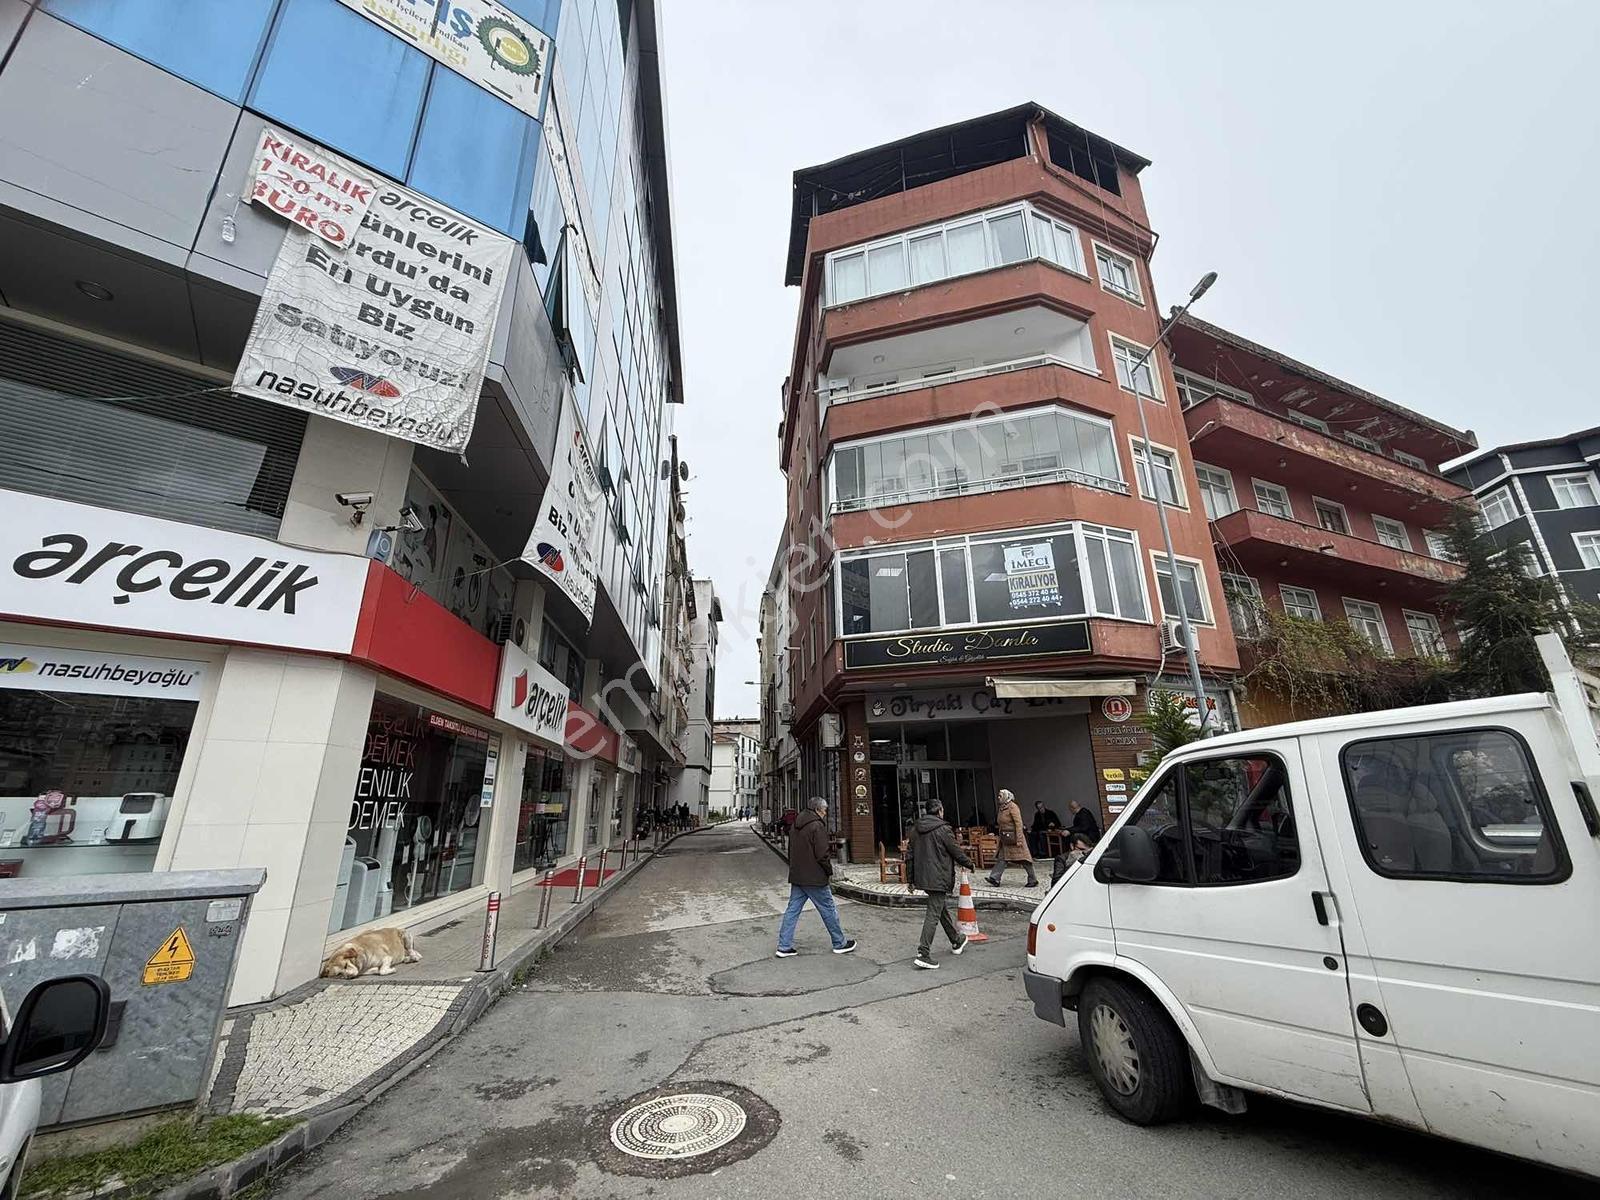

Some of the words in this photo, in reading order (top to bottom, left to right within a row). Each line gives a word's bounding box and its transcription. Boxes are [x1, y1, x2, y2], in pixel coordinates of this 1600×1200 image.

[262, 136, 371, 206] KİRALIK
[379, 192, 479, 246] arçelik
[357, 302, 416, 342] Biz
[365, 273, 475, 335] Uygun
[548, 505, 567, 539] Biz
[12, 533, 319, 615] arçelik
[1011, 555, 1049, 569] İMECİ
[886, 638, 954, 657] Studio
[964, 630, 1039, 651] Damla
[38, 660, 194, 688] nasuhbeyoğlu
[526, 682, 567, 731] arçelik
[972, 691, 1013, 714] Çay
[357, 766, 413, 798] ENİLİK
